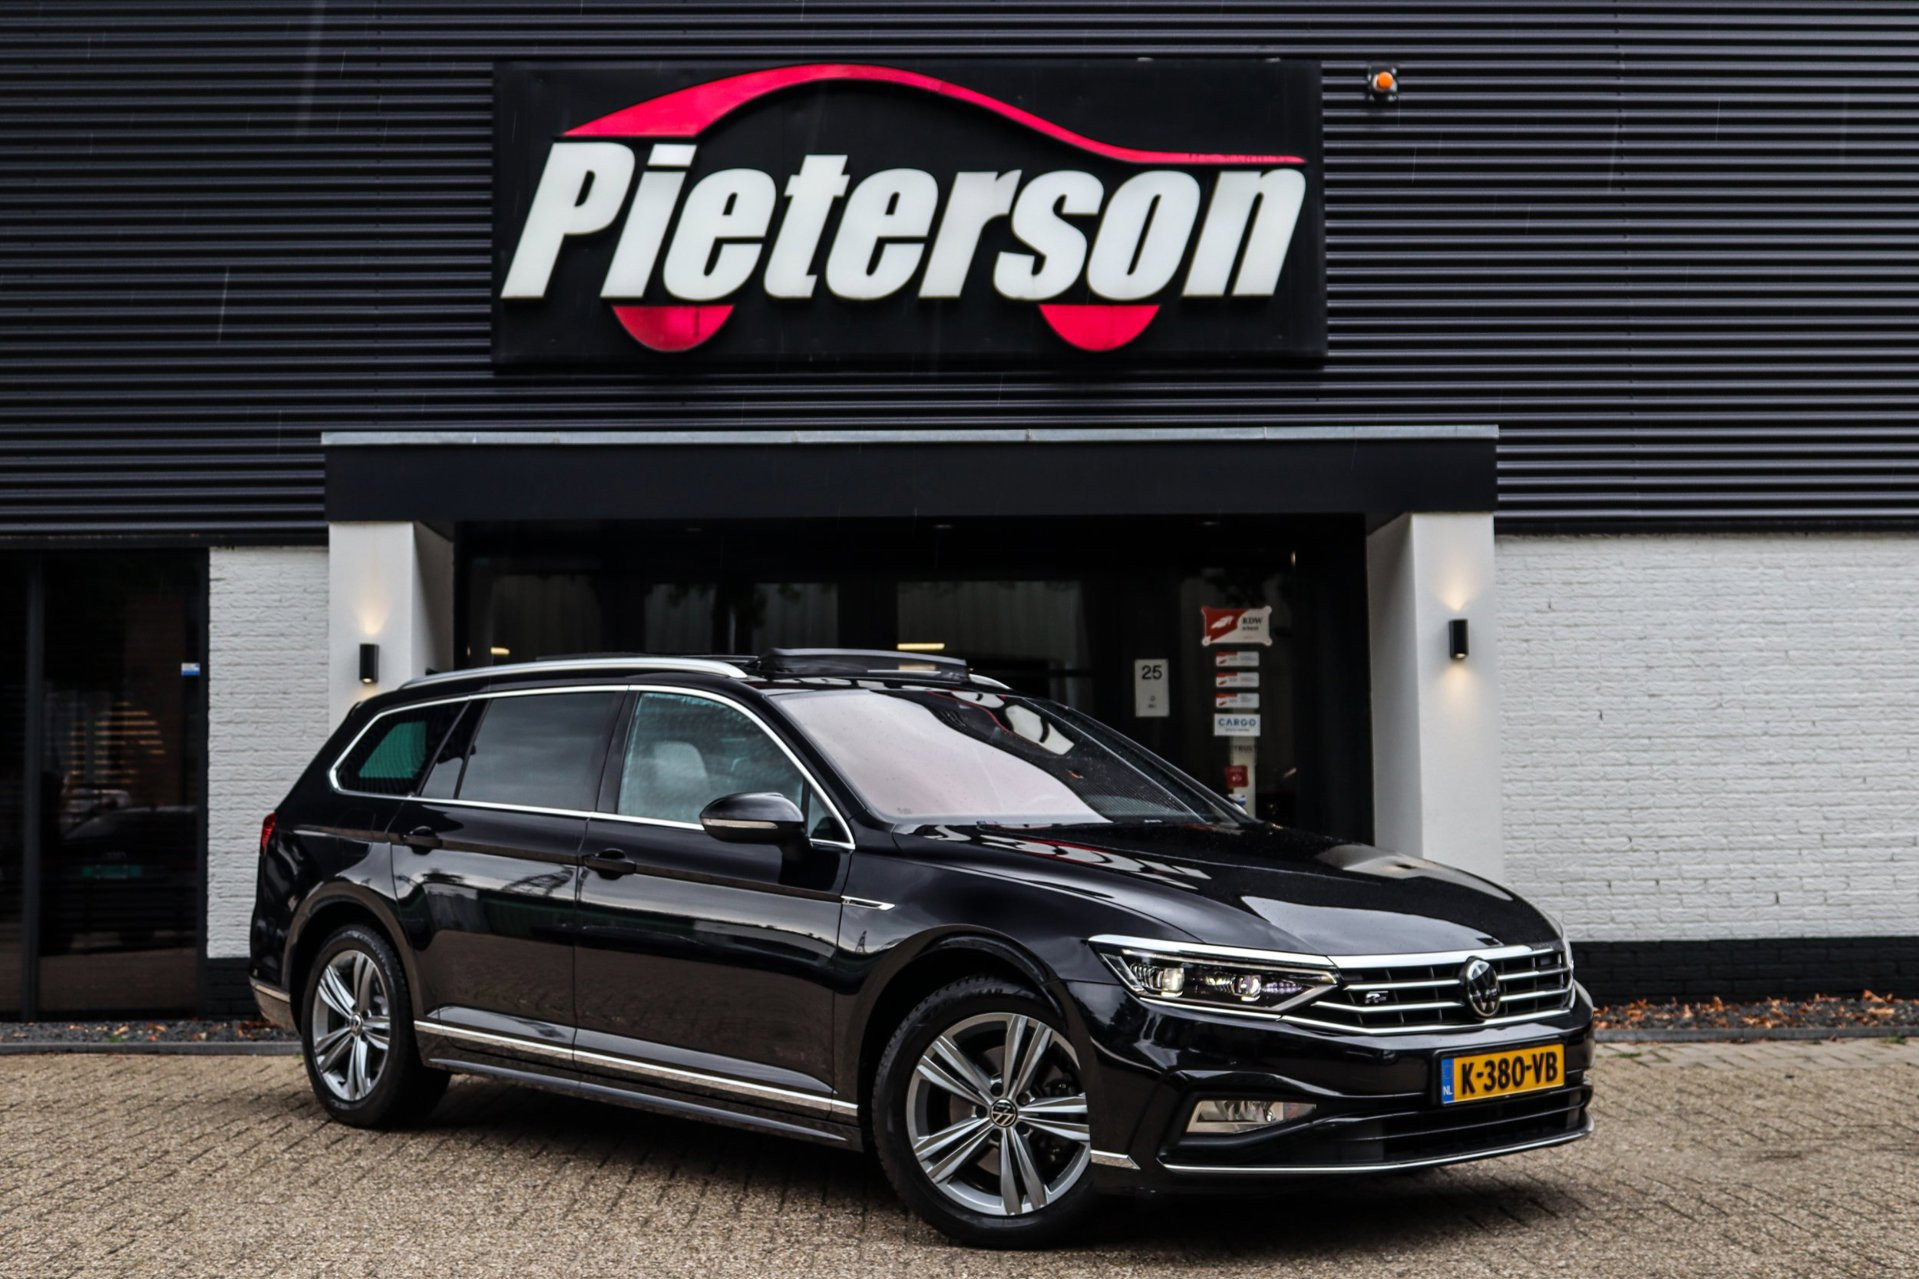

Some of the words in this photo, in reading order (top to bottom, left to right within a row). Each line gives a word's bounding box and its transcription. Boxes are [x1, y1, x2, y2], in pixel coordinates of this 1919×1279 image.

[500, 141, 1307, 301] Pieterson
[1242, 616, 1263, 625] RDW
[1141, 664, 1163, 680] 25
[1218, 717, 1257, 728] CARGO
[1461, 1052, 1558, 1095] K-380-VB
[1443, 1085, 1453, 1096] NL
